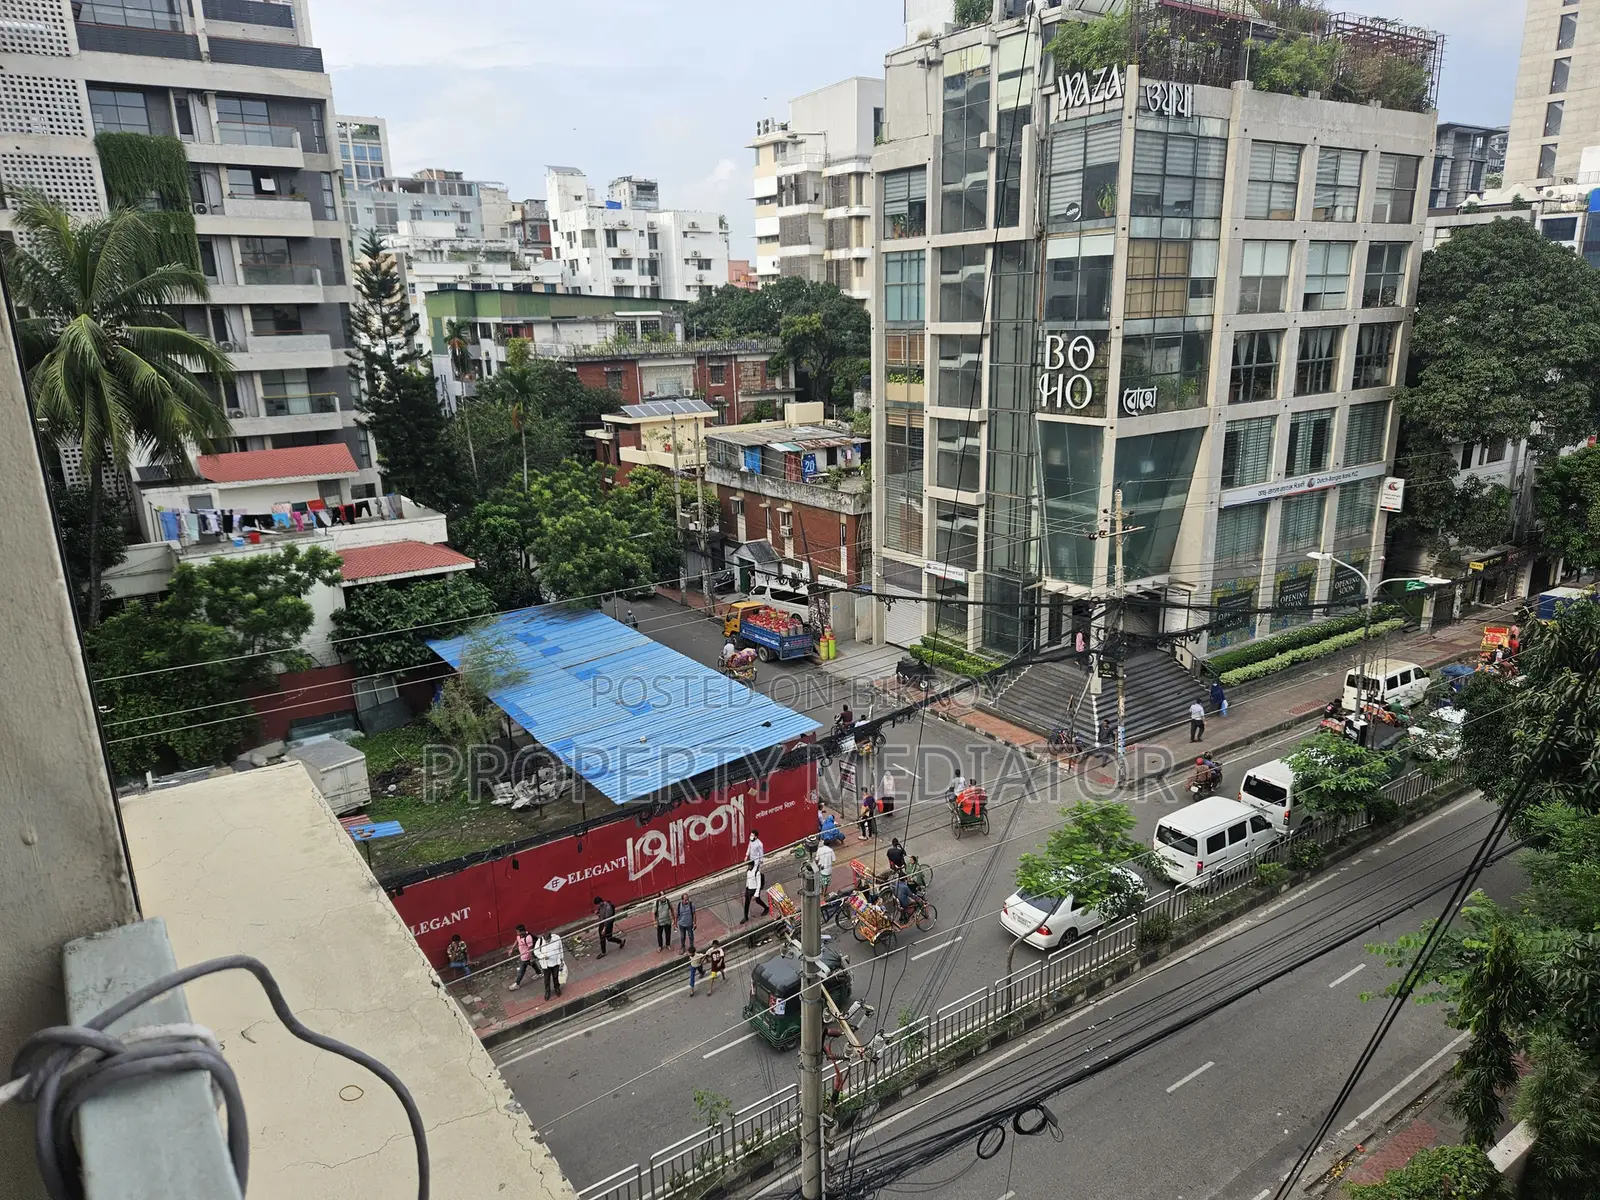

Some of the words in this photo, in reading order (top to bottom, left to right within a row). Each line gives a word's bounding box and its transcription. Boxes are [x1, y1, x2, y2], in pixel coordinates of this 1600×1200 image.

[1057, 64, 1124, 109] WAZA
[1044, 335, 1095, 371] BO
[1039, 373, 1093, 410] HO
[804, 460, 815, 472] 20
[1280, 589, 1308, 604] OPENING
[1334, 575, 1360, 590] OPENING
[1338, 585, 1355, 596] SOON
[567, 855, 627, 885] ELEGANT
[409, 907, 471, 936] LEGANT
